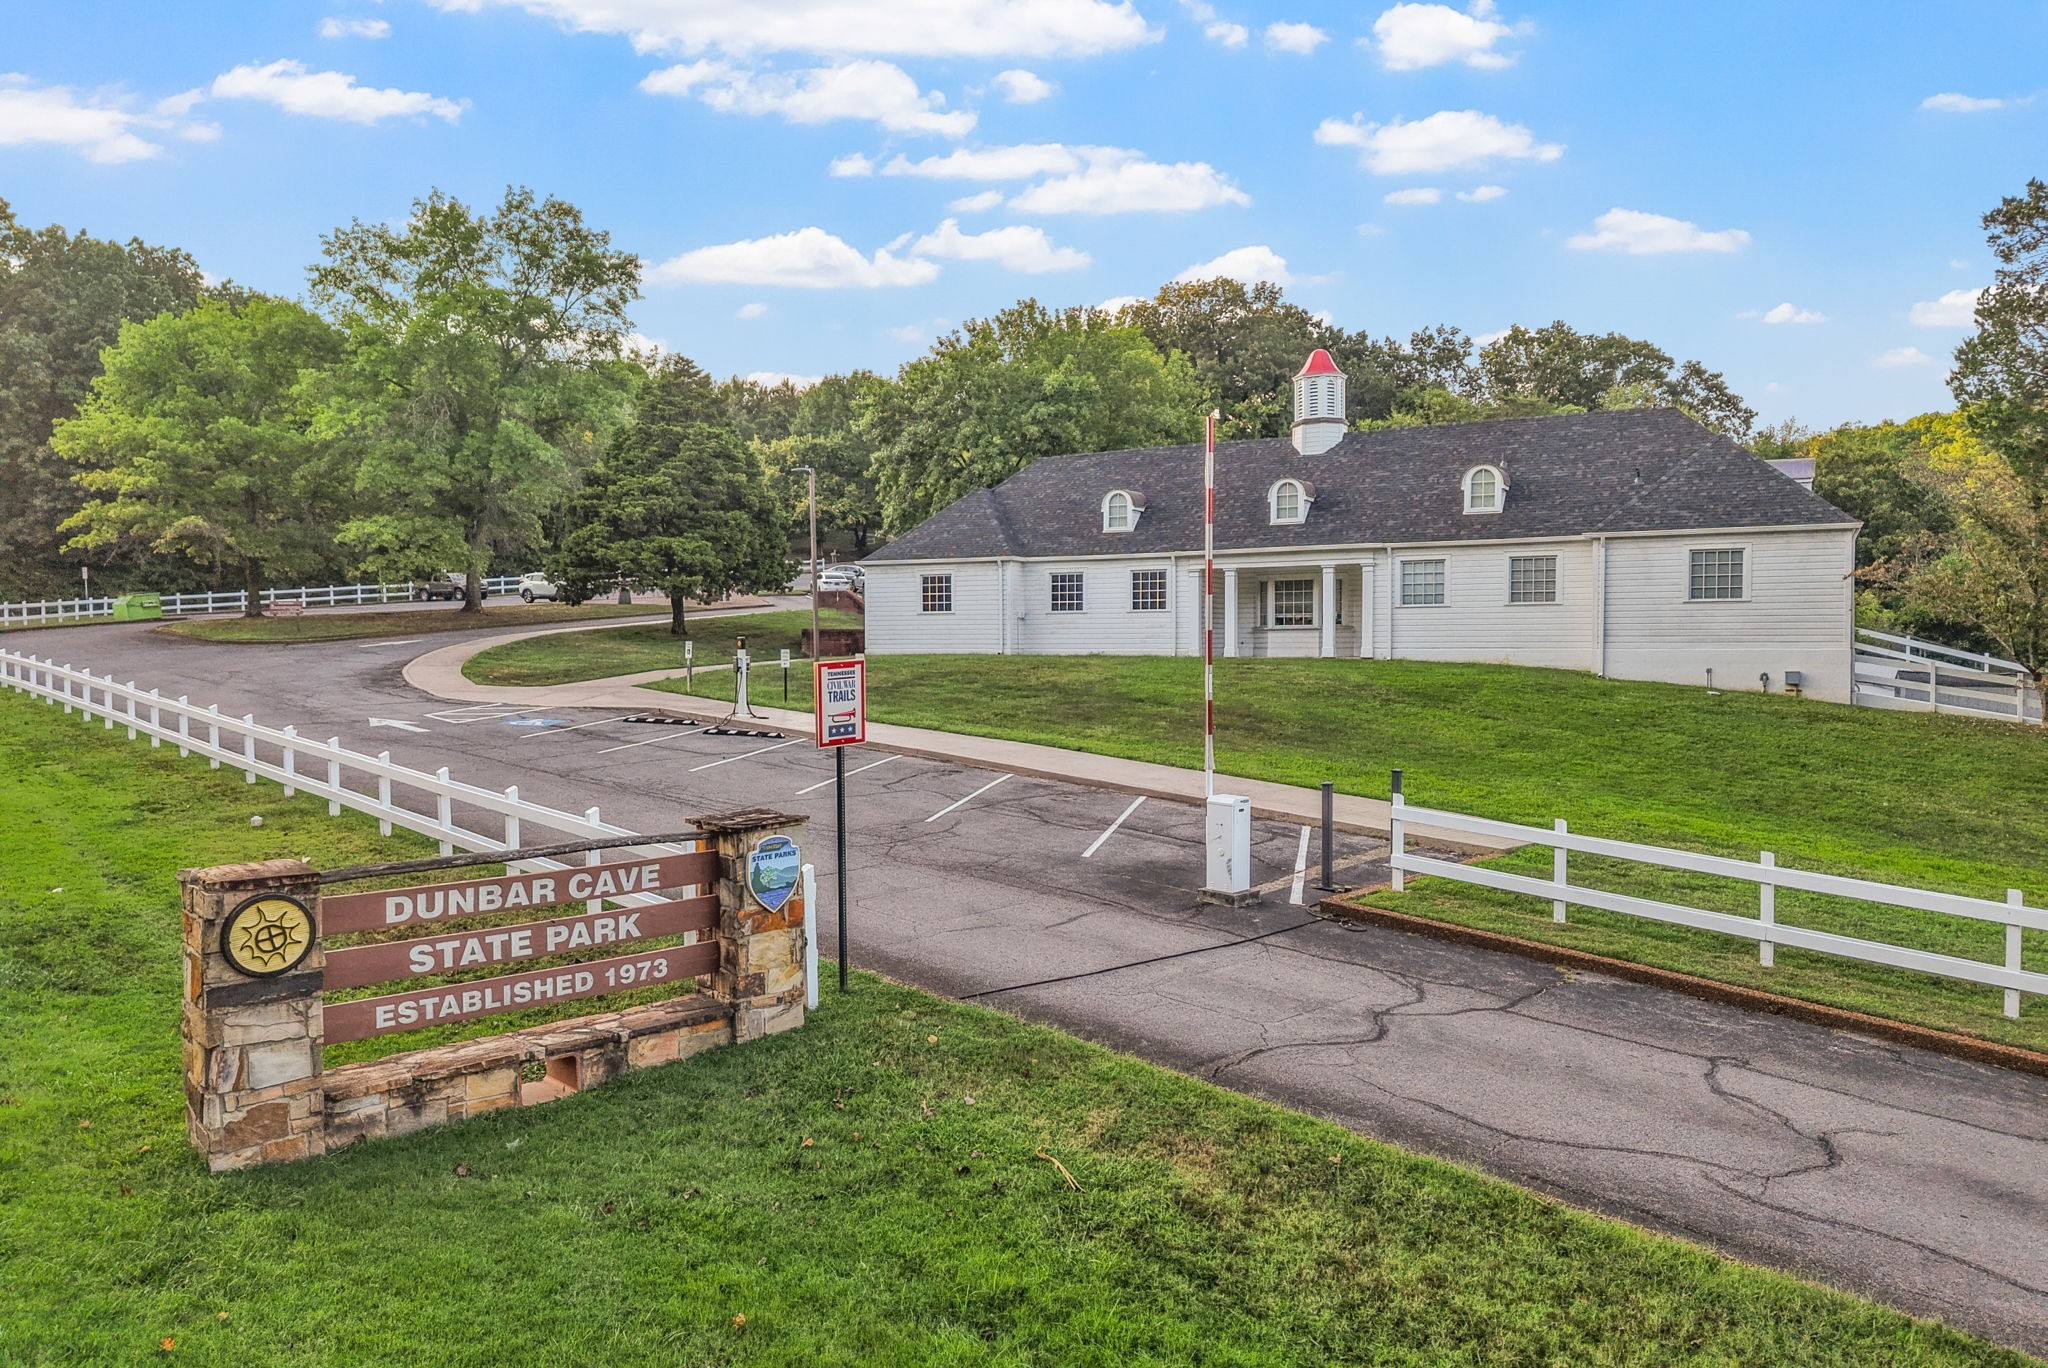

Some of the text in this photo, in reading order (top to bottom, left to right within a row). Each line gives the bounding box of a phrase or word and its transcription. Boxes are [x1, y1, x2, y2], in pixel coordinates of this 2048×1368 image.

[827, 680, 856, 690] CIVIL WAR
[827, 689, 856, 703] TRAILS
[752, 850, 796, 862] STATE PARKS
[385, 863, 661, 924] DUNBAR CAVE
[409, 912, 642, 973] STATE PARK
[375, 958, 668, 1029] ESTABLISHED 1973
